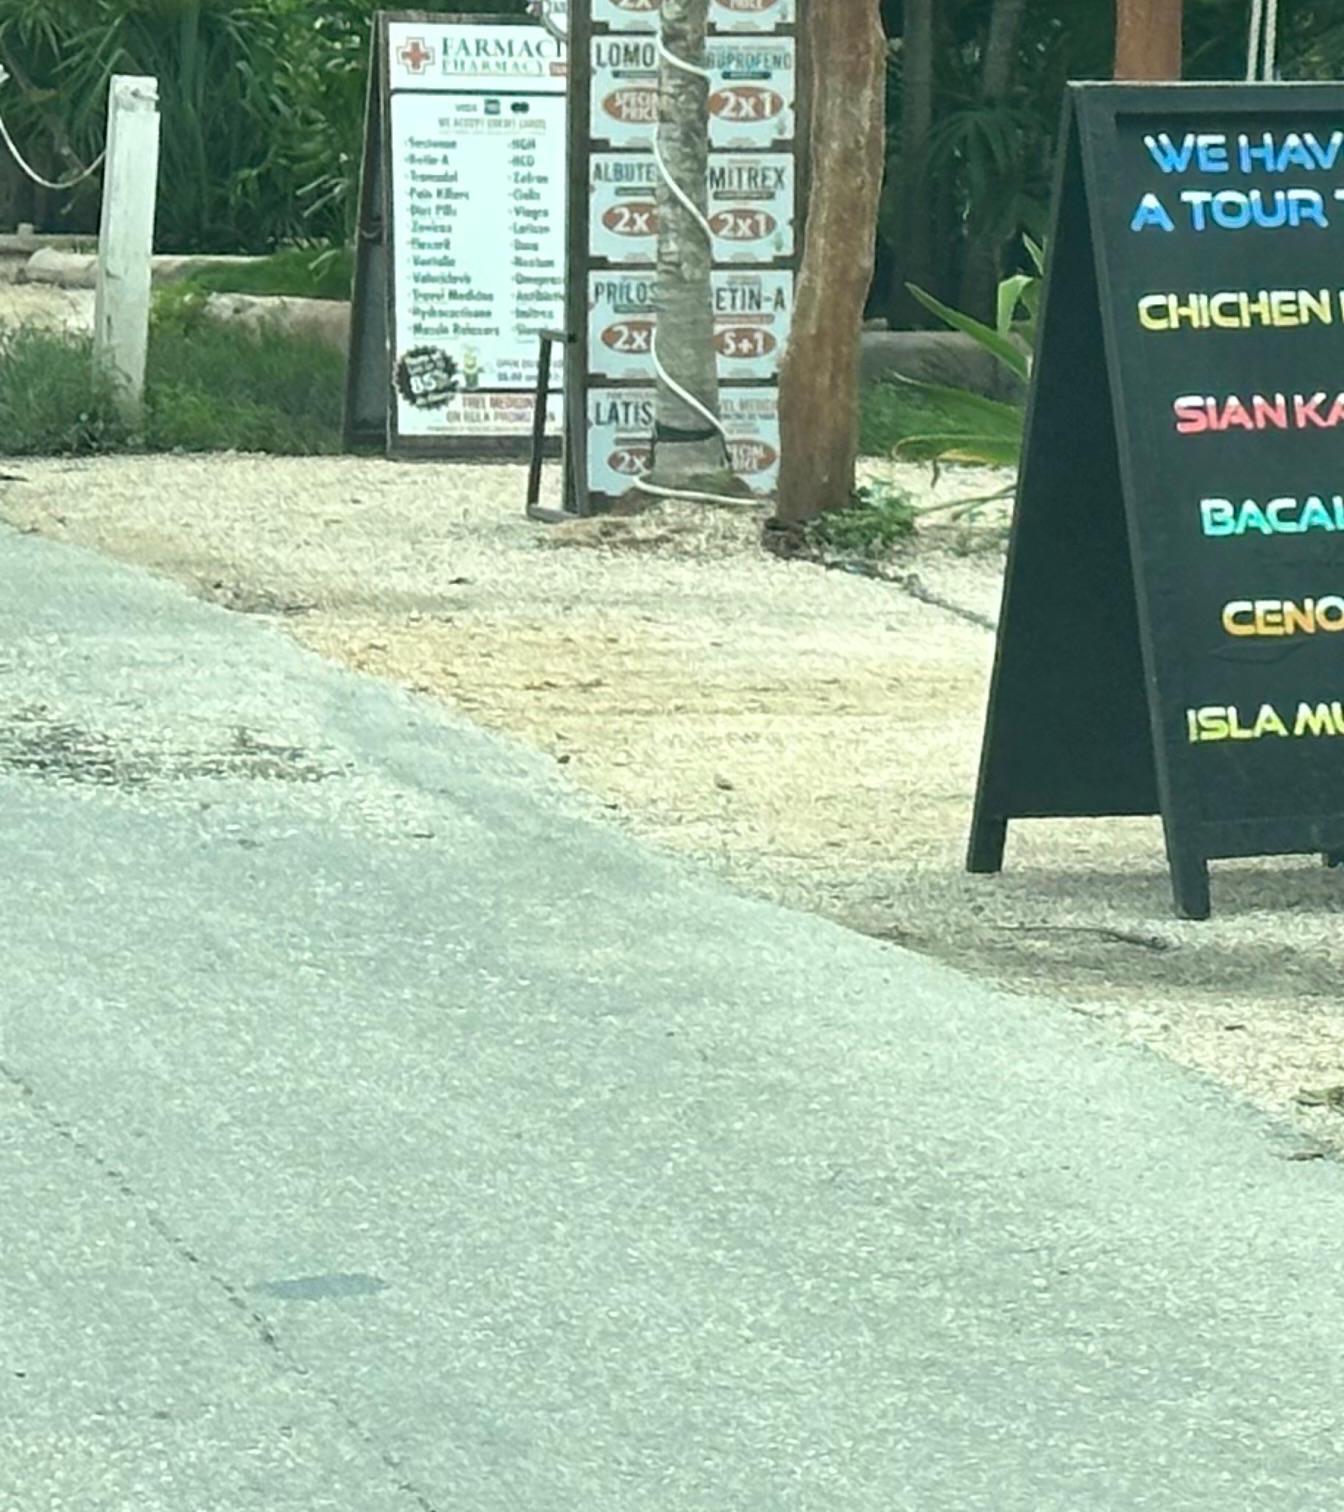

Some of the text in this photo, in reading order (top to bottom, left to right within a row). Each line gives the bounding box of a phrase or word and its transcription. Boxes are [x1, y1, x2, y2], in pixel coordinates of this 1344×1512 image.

[721, 91, 773, 118] 2x1
[1144, 132, 1230, 173] WE
[719, 213, 768, 237] 2x1
[1130, 192, 1175, 232] A
[1180, 188, 1329, 230] TOUR
[1137, 289, 1333, 331] CHICHEN
[1173, 391, 1288, 434] SIAN
[1185, 703, 1289, 743] ISLA
